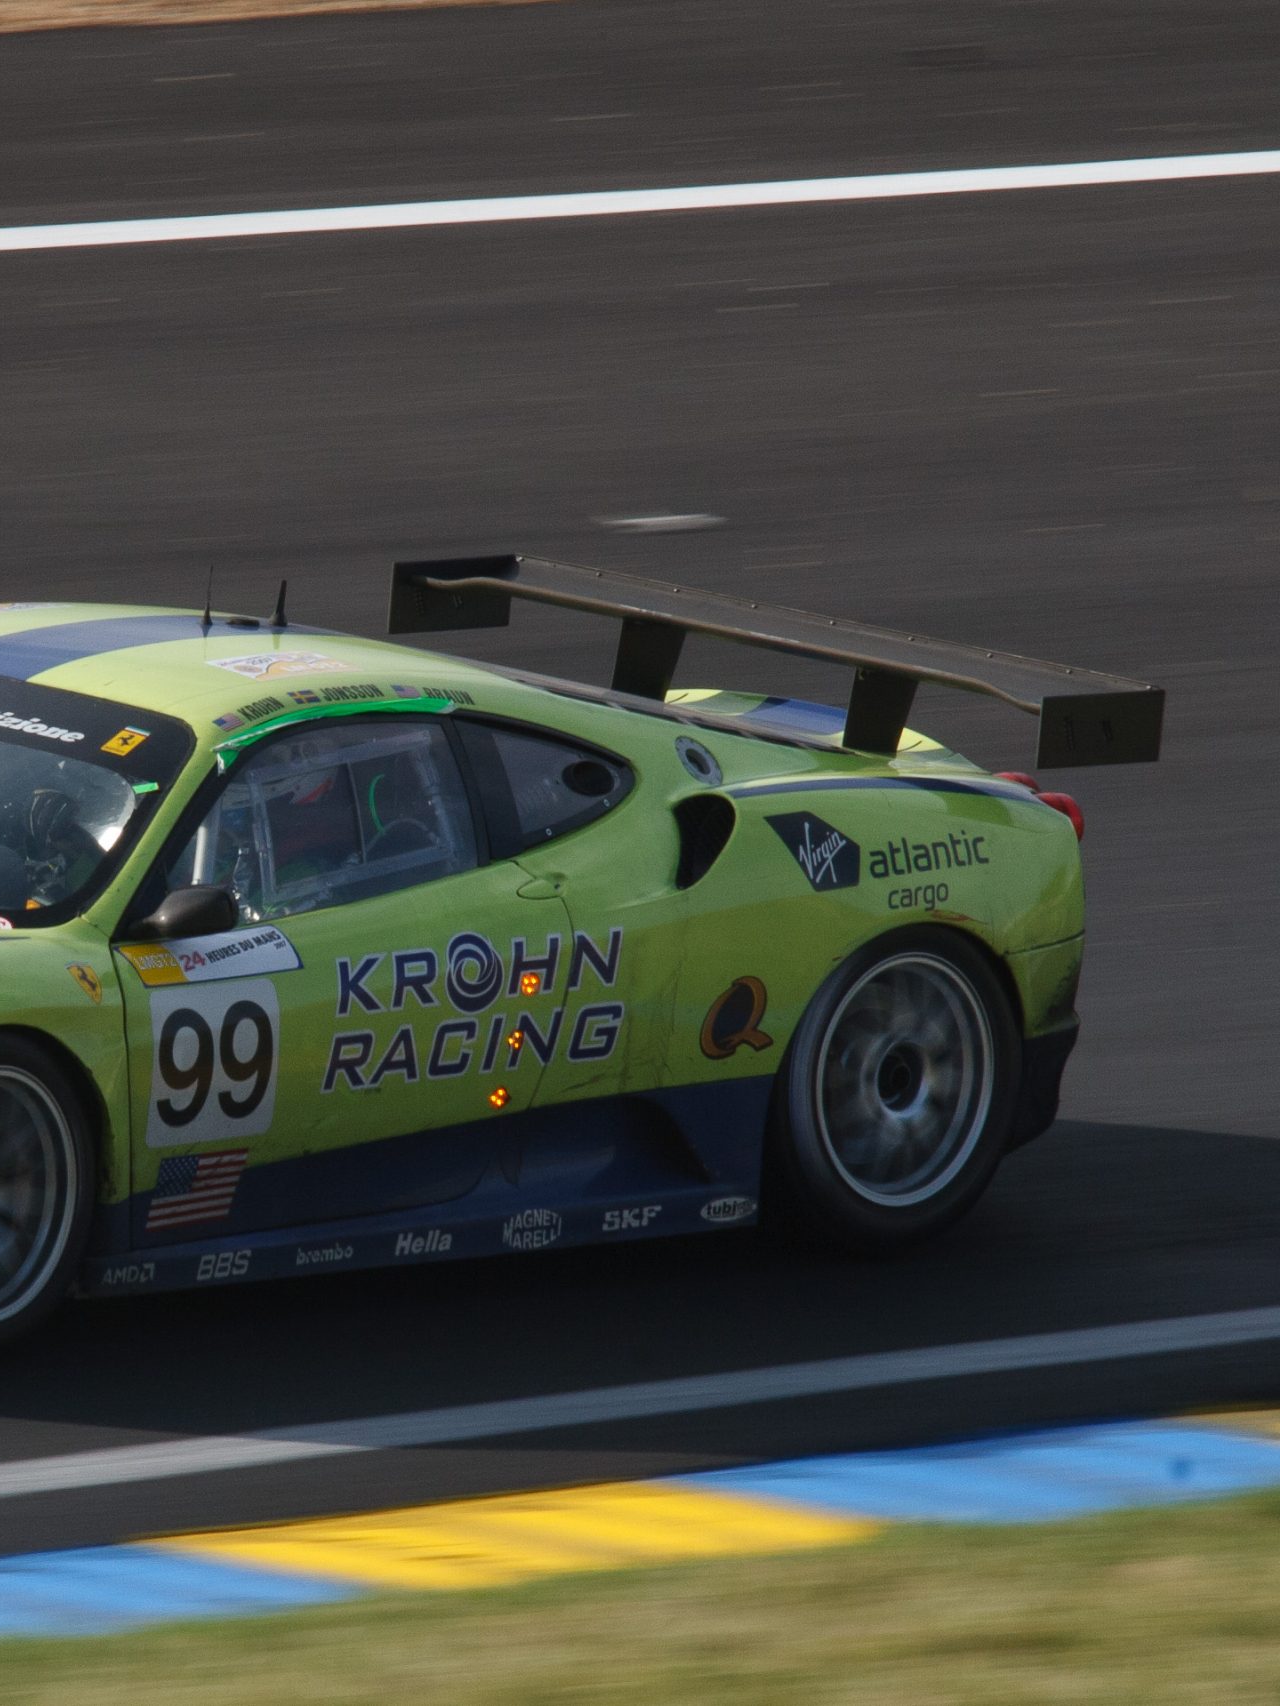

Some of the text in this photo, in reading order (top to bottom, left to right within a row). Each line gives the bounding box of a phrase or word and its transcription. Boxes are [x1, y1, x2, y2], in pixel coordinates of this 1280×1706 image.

[237, 696, 285, 722] KROHN
[322, 684, 384, 702] JONSSON
[799, 821, 846, 884] Virgin
[869, 830, 990, 878] atlantic
[888, 883, 948, 911] cargo
[179, 951, 206, 972] 24
[205, 943, 241, 963] HEURES
[240, 938, 255, 952] DU
[253, 930, 282, 948] MANS
[336, 926, 623, 1017] KROHN
[157, 1000, 273, 1128] 99
[320, 1001, 623, 1093] RACING
[503, 1208, 562, 1233] MAGNETI
[602, 1205, 662, 1231] SKF
[706, 1201, 737, 1217] tubi
[395, 1229, 452, 1256] Hella
[101, 1264, 141, 1285] AMD
[197, 1249, 252, 1281] BBS
